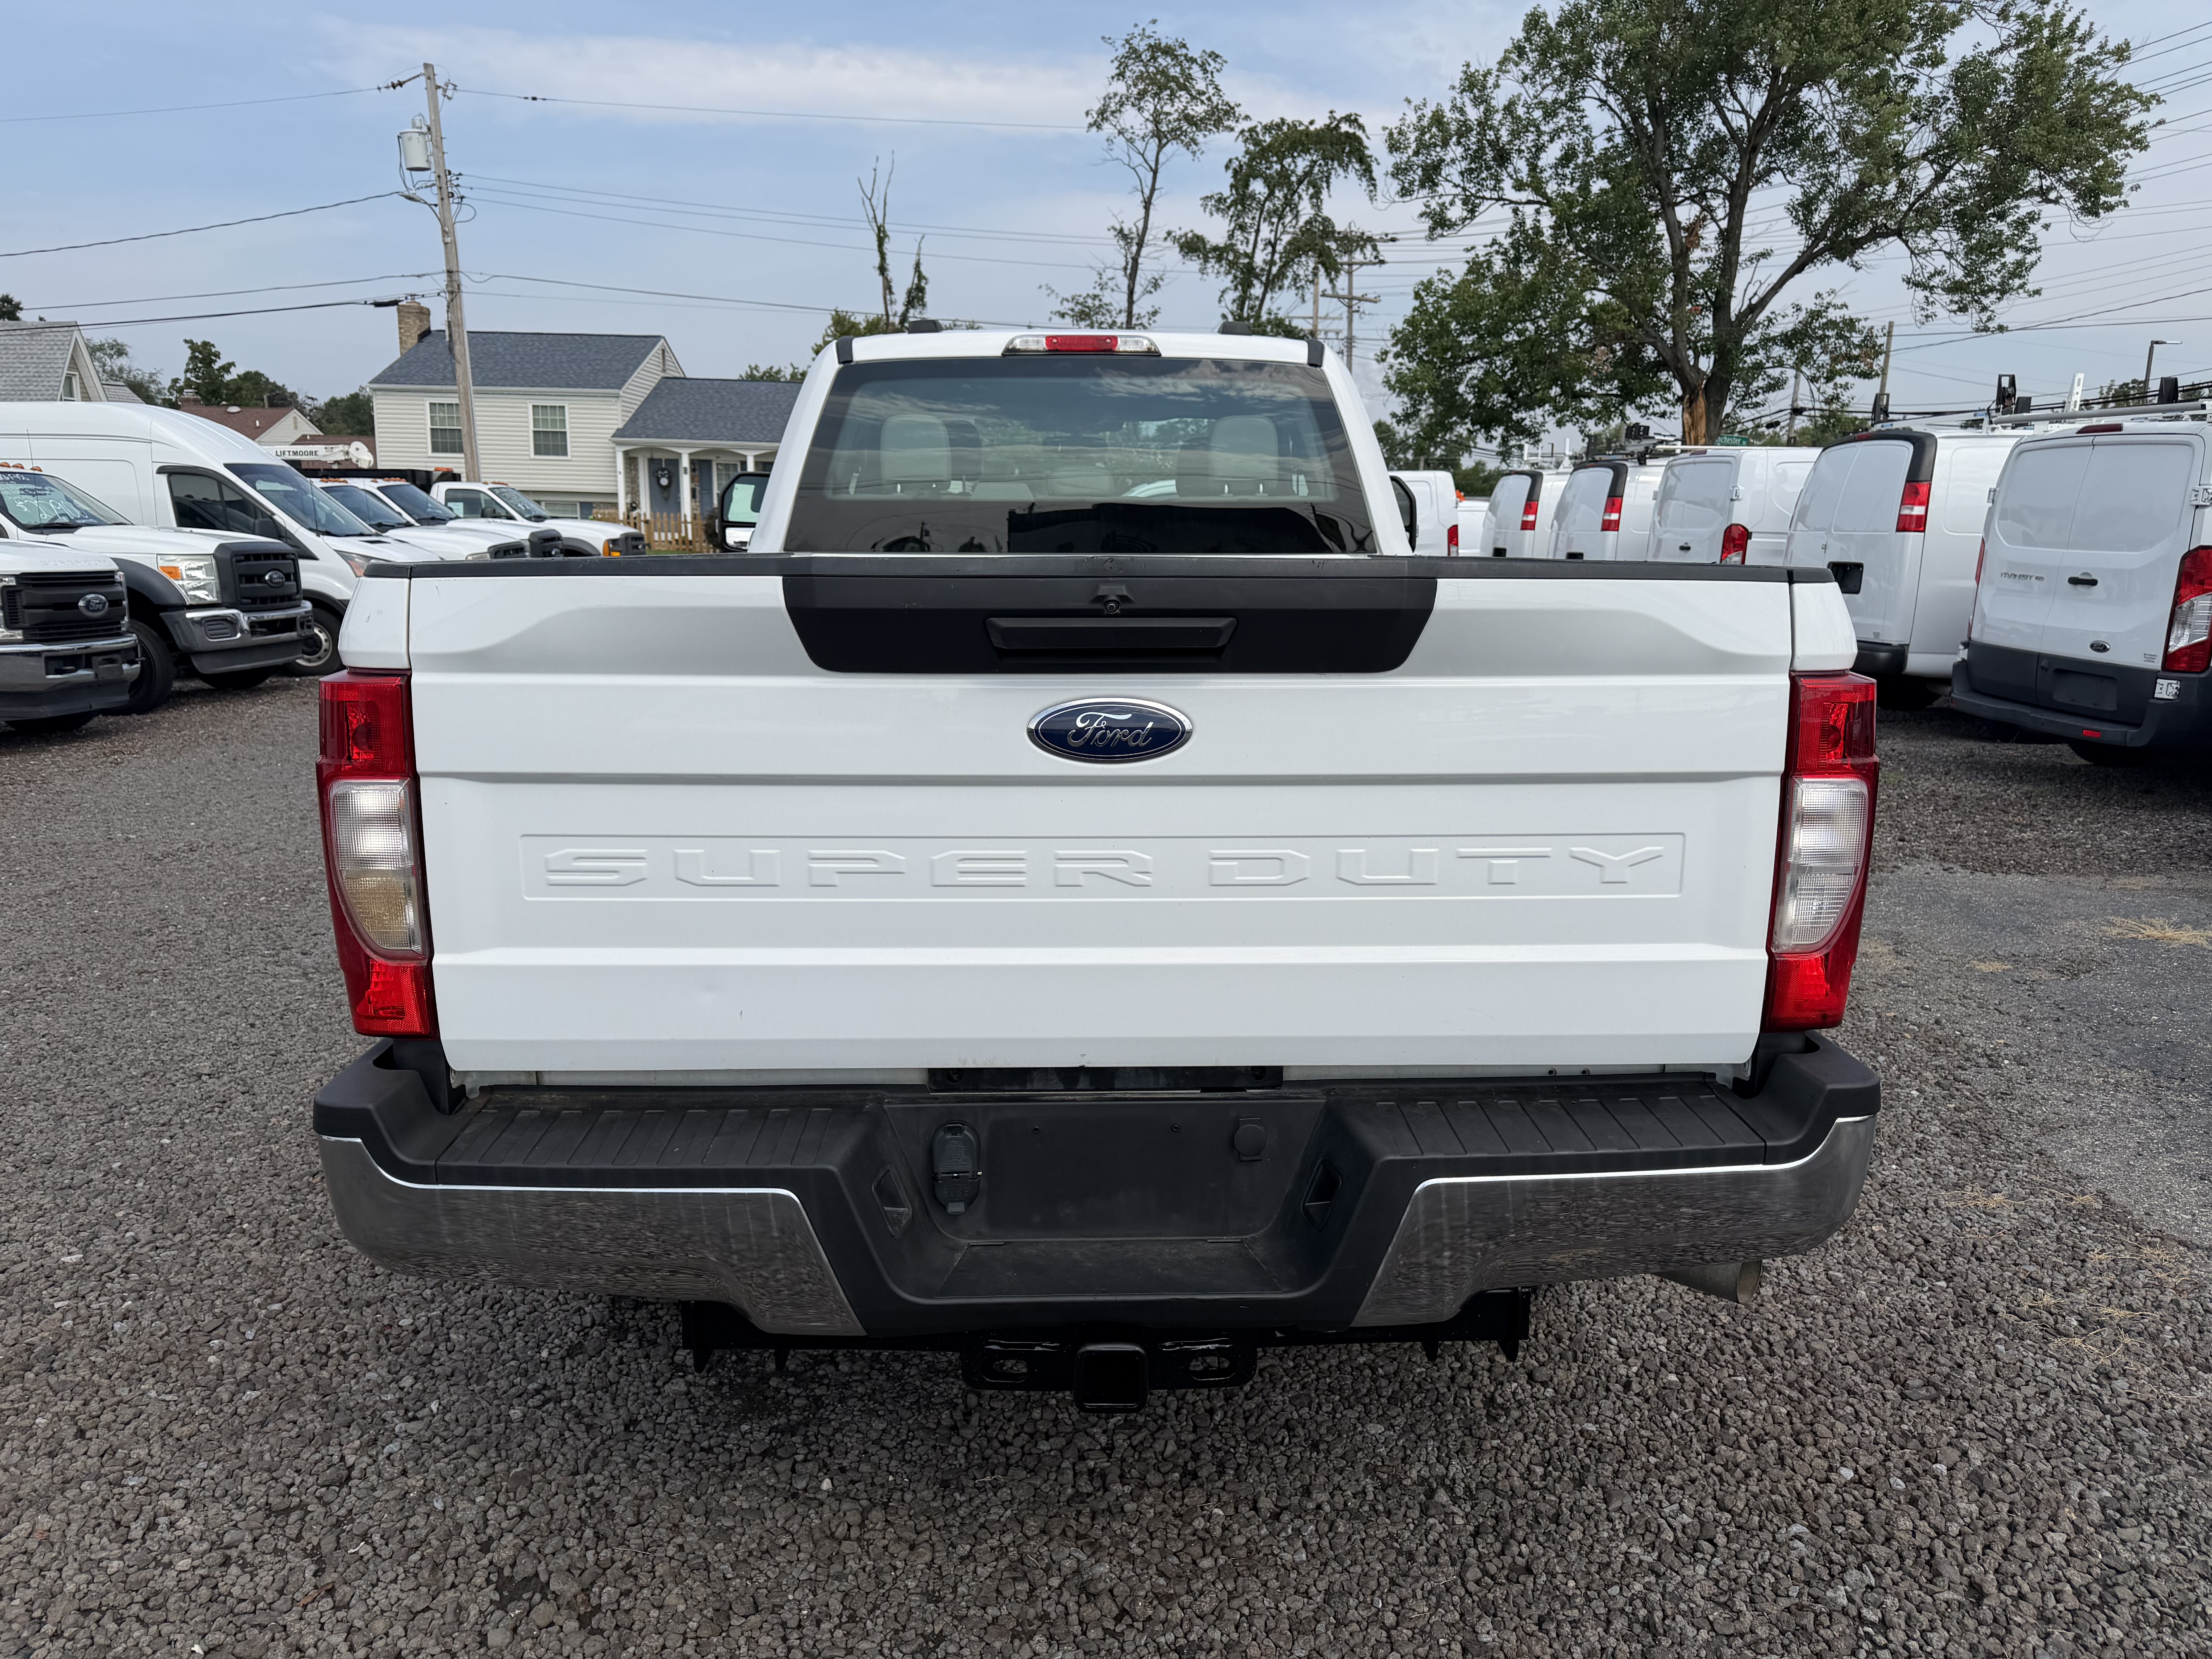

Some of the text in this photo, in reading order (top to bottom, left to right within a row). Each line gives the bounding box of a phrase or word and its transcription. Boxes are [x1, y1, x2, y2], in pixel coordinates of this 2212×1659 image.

[89, 599, 103, 610] Ford
[1067, 711, 1154, 747] Ford
[545, 846, 1664, 887] SUPER DUTY
